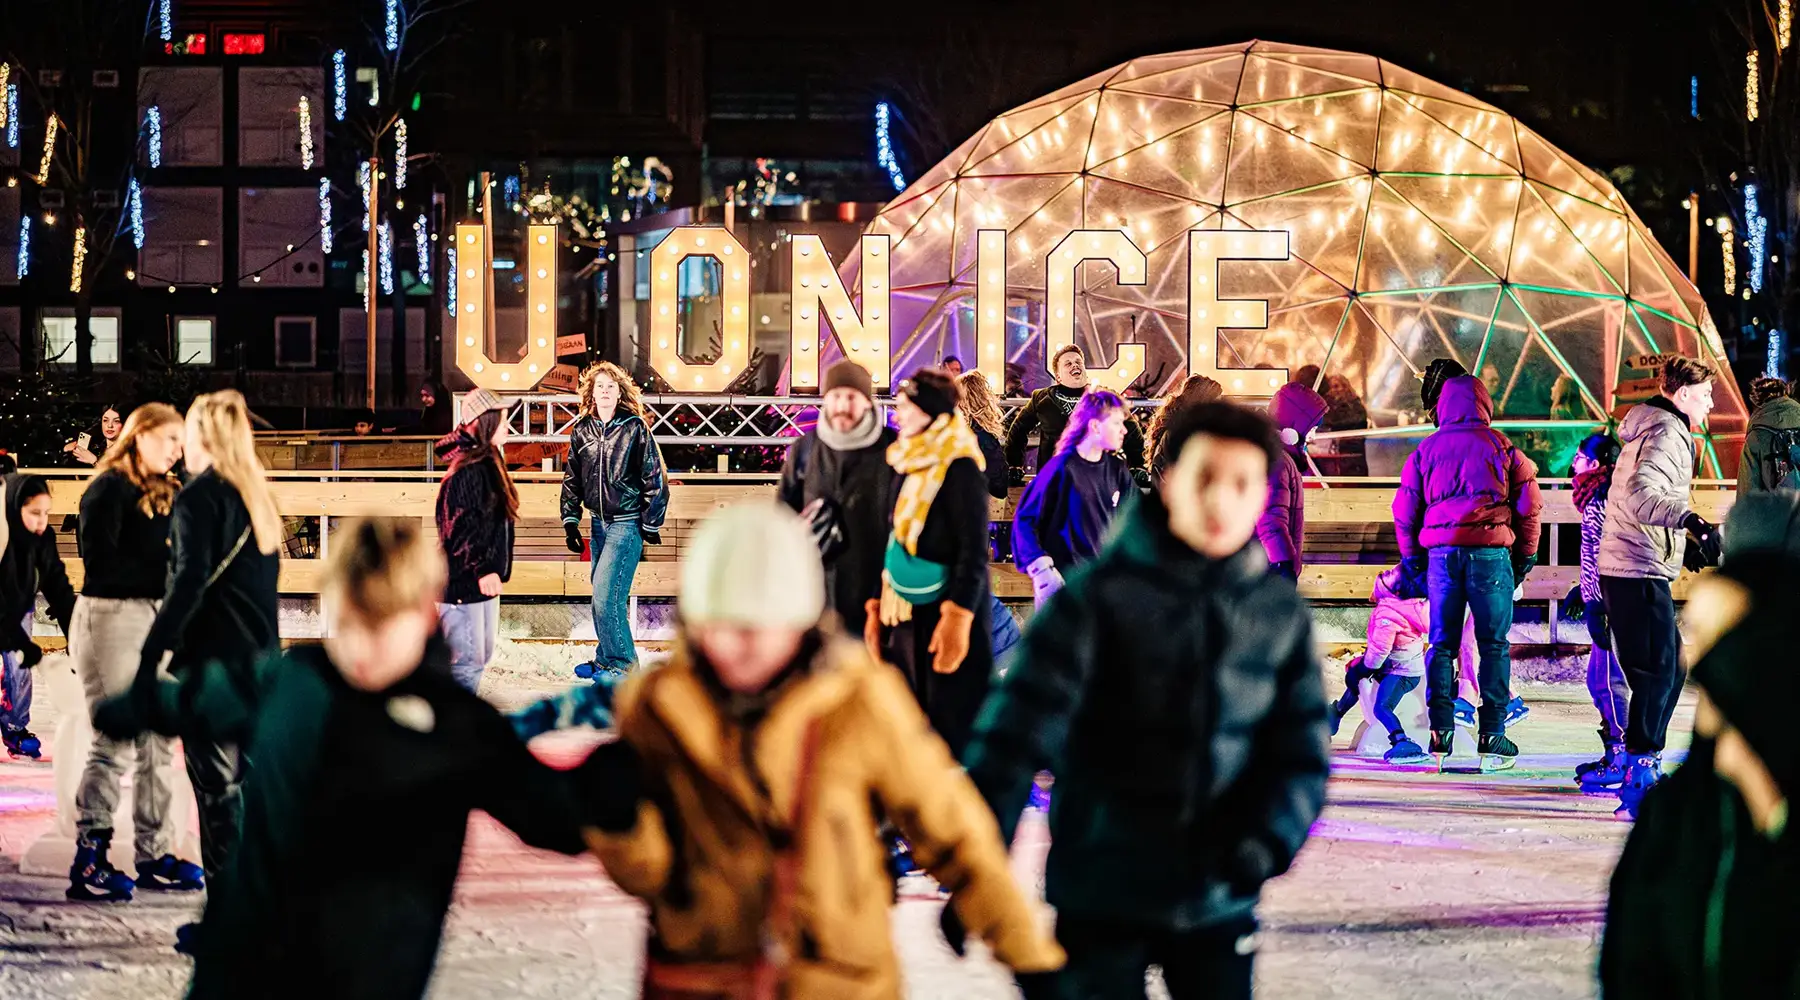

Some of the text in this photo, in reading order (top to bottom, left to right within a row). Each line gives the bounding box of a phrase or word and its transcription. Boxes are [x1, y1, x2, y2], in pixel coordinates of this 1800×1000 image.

[456, 223, 1290, 396] U ON ICE
